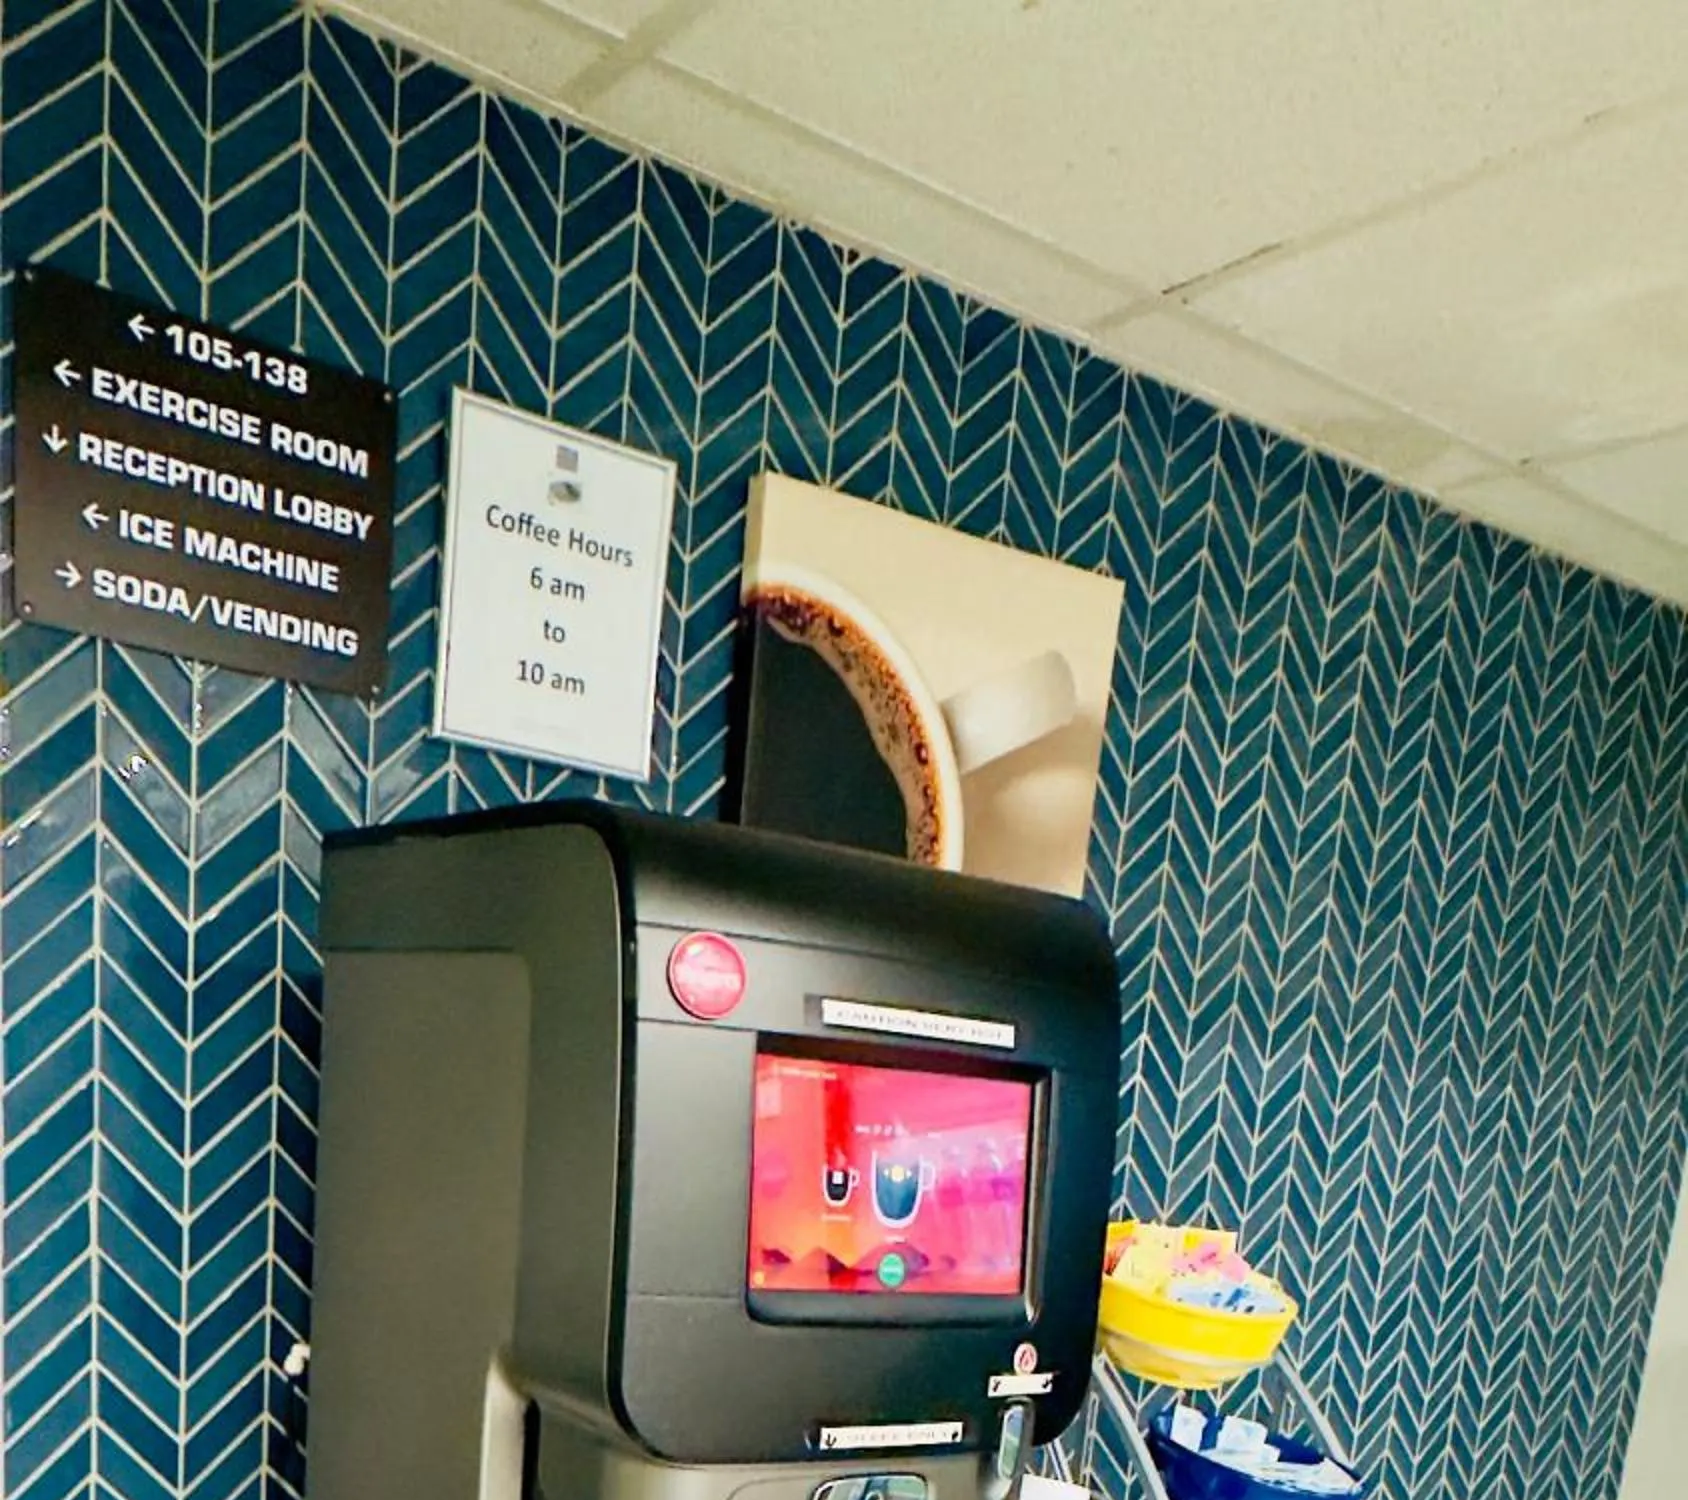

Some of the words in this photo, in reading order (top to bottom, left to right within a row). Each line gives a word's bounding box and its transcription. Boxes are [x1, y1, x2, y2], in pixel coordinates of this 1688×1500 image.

[165, 325, 309, 395] 105-138
[92, 367, 262, 445] EXERCISE
[270, 421, 370, 479] ROOM
[78, 431, 266, 512] RECEPTION
[274, 488, 375, 542] LOBBY
[119, 509, 174, 550] ICE
[183, 526, 340, 593] MACHINE
[485, 503, 560, 547] Coffee
[568, 527, 634, 568] Hours
[92, 568, 360, 658] SODA/VENDING
[529, 566, 543, 591] 6
[549, 574, 586, 602] am
[542, 619, 566, 644] to
[516, 659, 545, 686] 10
[550, 670, 585, 695] am
